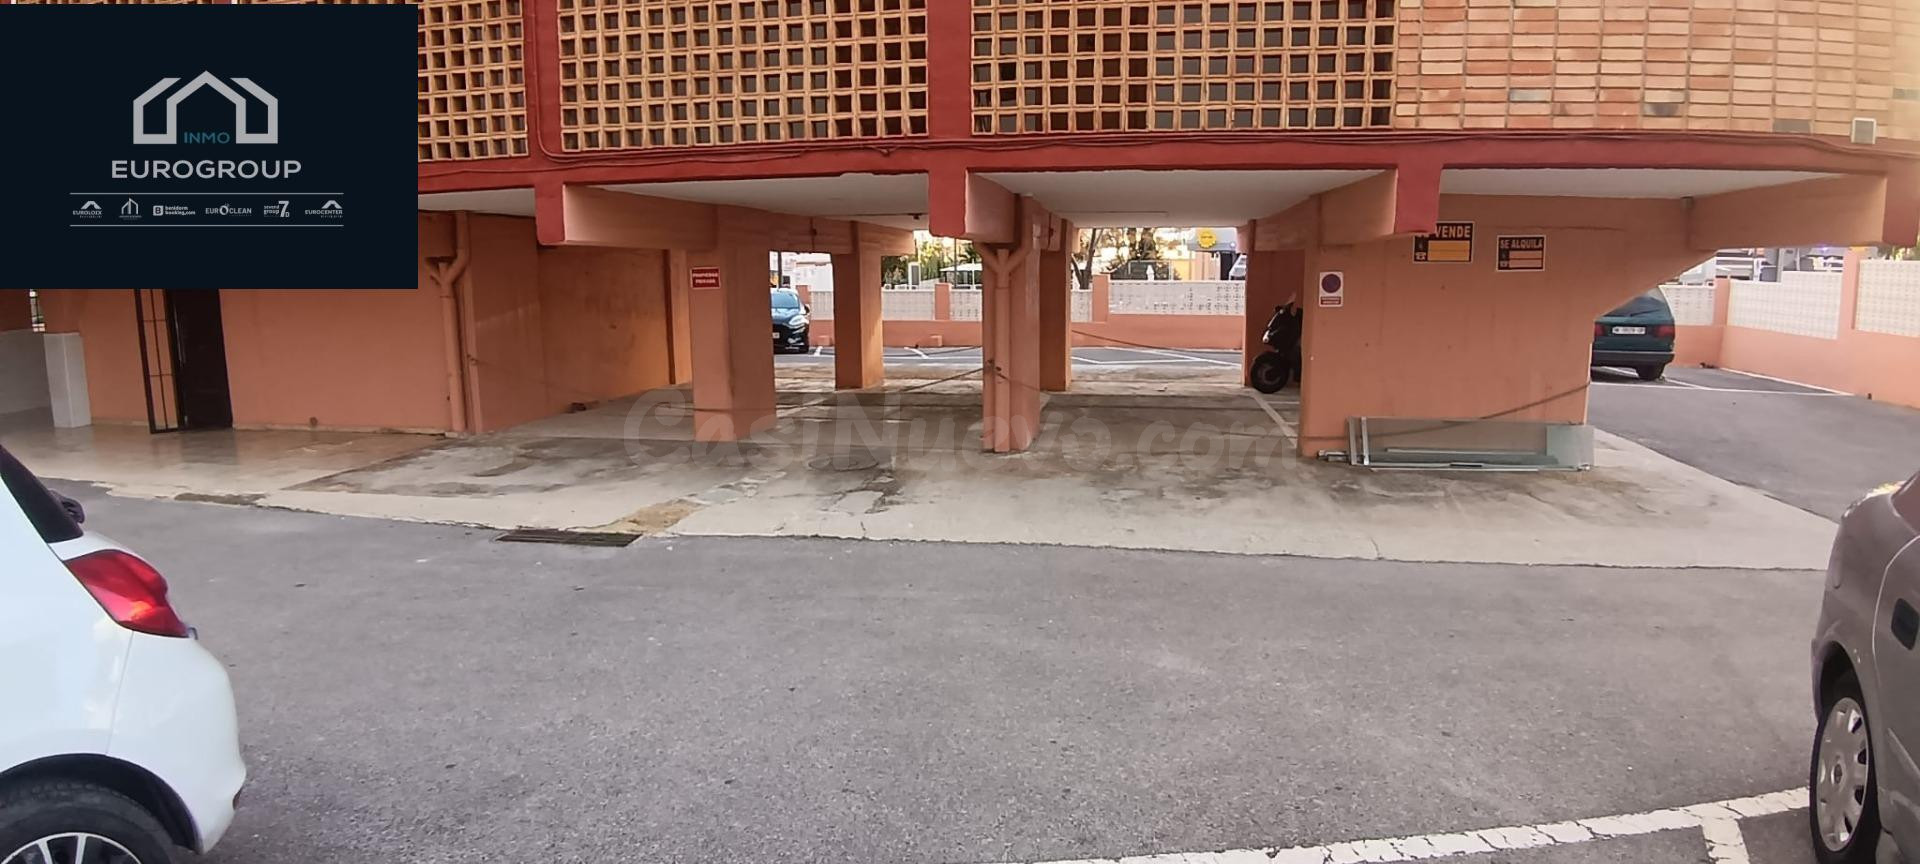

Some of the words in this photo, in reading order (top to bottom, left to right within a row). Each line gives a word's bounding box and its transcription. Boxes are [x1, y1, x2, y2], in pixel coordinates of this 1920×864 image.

[1435, 226, 1471, 238] VENDE
[1500, 239, 1510, 249] SE
[1511, 238, 1543, 249] ALQUILA
